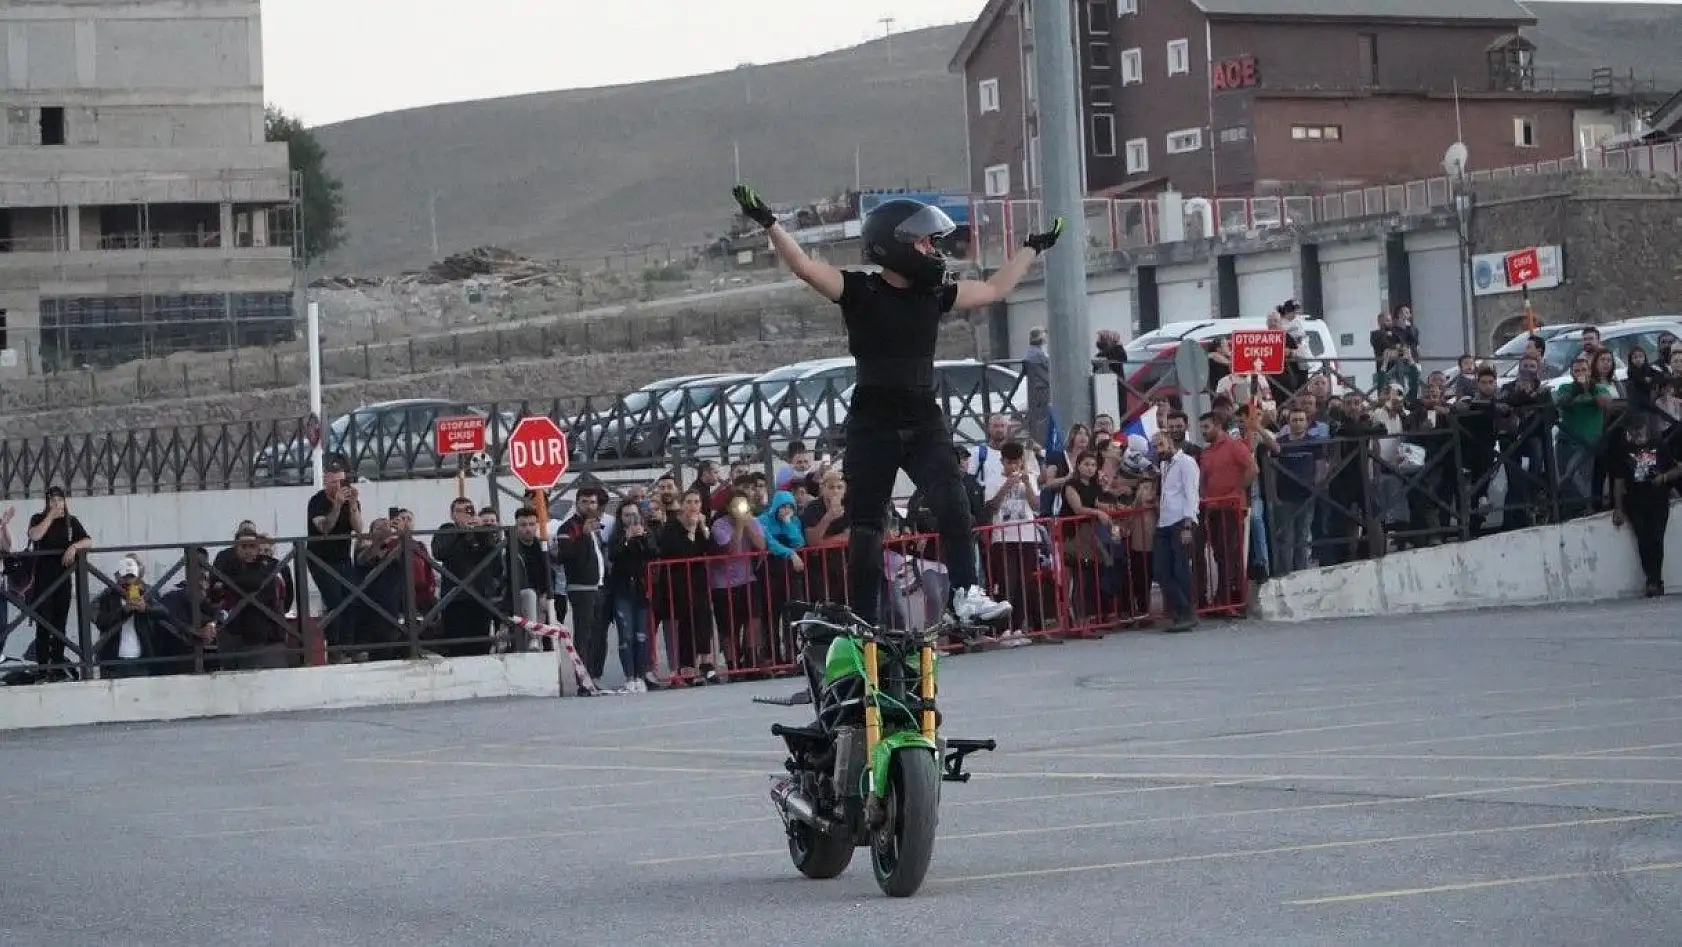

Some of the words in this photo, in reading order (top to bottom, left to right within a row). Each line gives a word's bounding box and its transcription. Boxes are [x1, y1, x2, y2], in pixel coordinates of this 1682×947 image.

[1235, 333, 1281, 345] OTOPARK
[440, 420, 482, 431] OTOPARK
[513, 438, 563, 468] DUR
